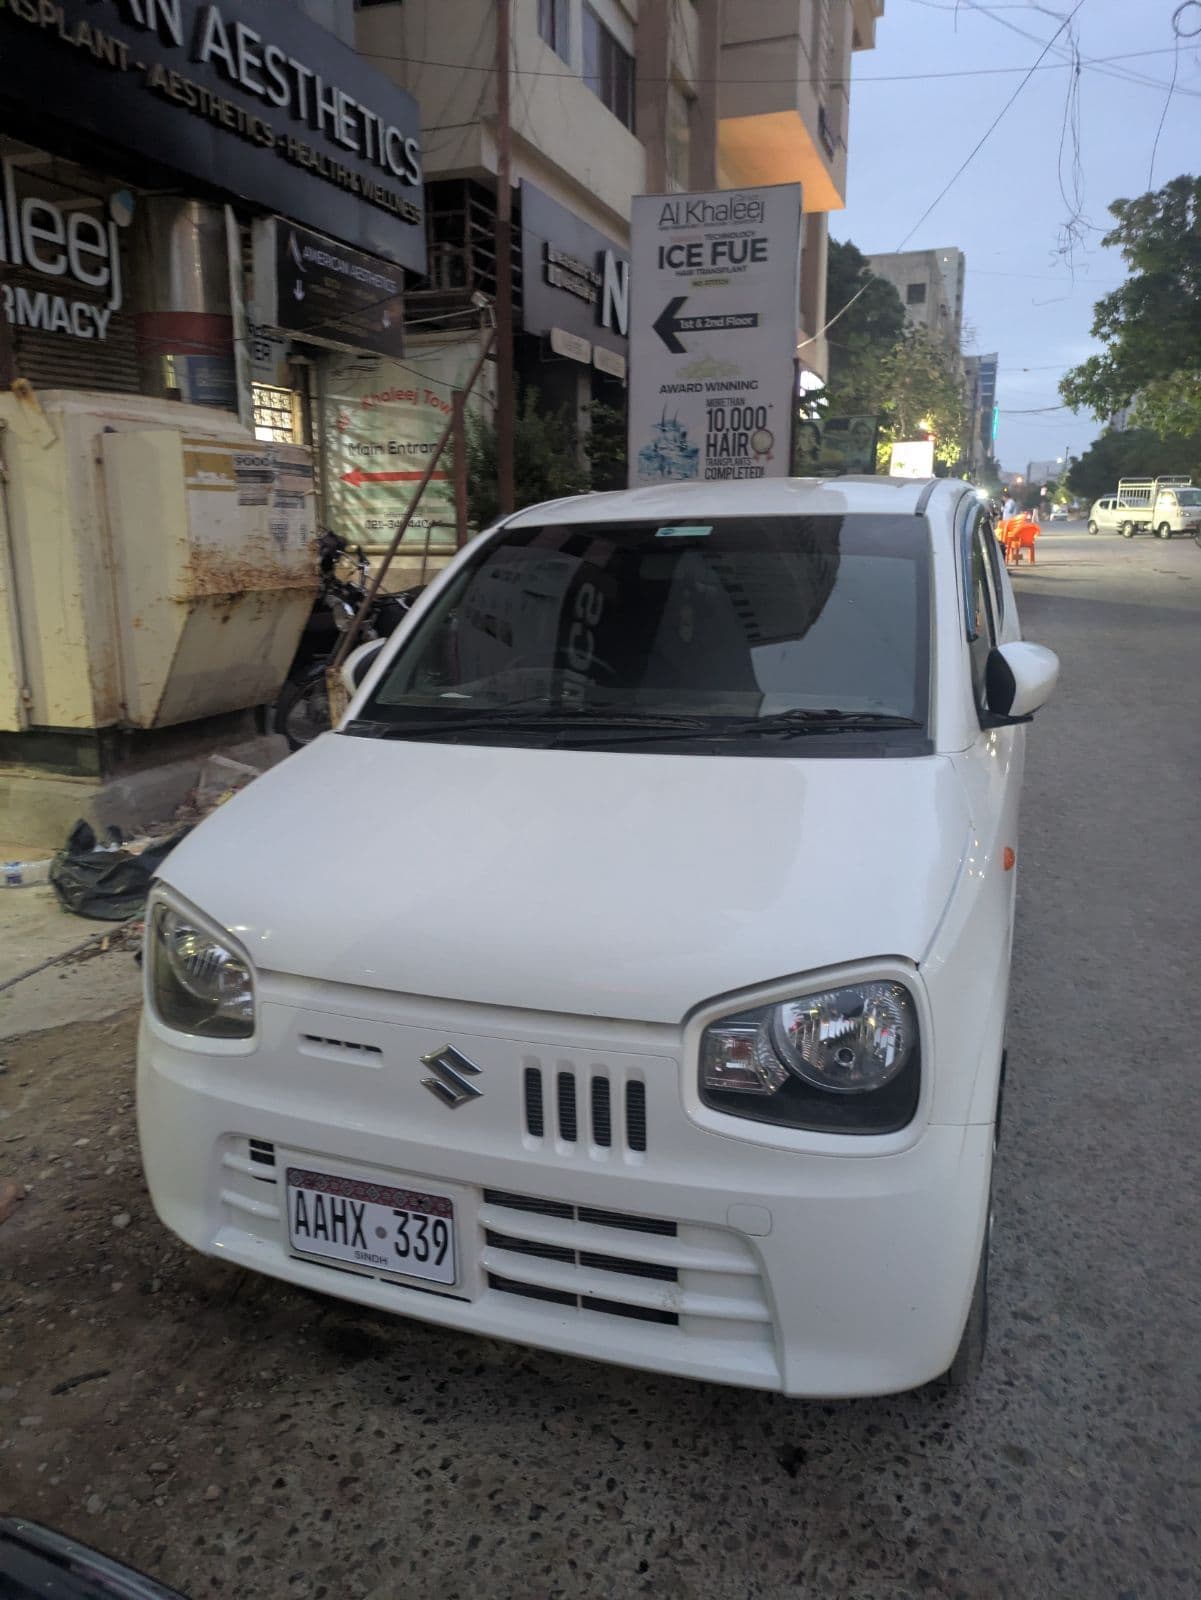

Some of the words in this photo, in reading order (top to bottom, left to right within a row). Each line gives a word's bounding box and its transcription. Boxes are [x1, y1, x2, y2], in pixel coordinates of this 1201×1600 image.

[146, 64, 274, 149] AESTHETICS
[200, 5, 421, 186] AESTHETICS
[658, 202, 679, 225] Al
[686, 197, 765, 224] Khaleej
[0, 156, 135, 310] leej
[658, 243, 703, 269] ICE
[711, 238, 768, 267] FUE
[696, 265, 748, 276] TRANSPLANT
[602, 249, 629, 336] N
[680, 320, 695, 329] 1st
[704, 317, 725, 328] 2nd
[726, 315, 754, 327] Floor
[659, 383, 703, 394] AWARD
[704, 380, 759, 392] WINNING
[423, 388, 455, 415] Tow
[349, 442, 384, 457] Main
[706, 432, 749, 458] HAIR
[295, 1190, 368, 1250] AAHX
[393, 1209, 448, 1266] 339
[354, 1250, 388, 1265] SINDH
